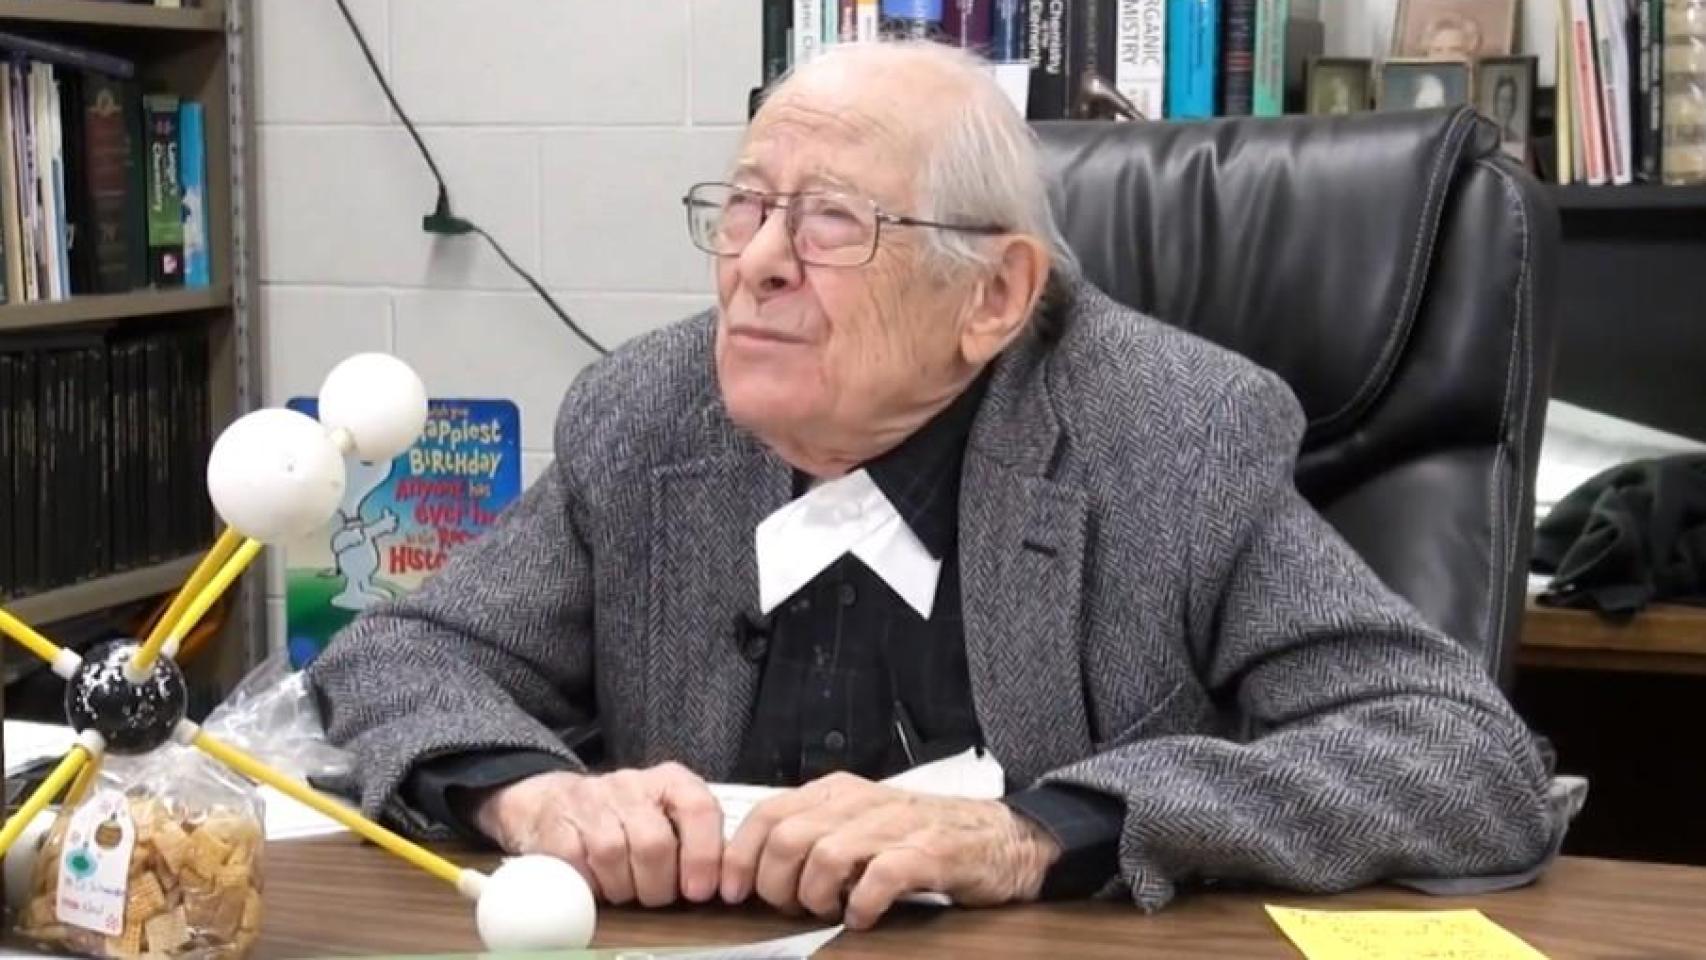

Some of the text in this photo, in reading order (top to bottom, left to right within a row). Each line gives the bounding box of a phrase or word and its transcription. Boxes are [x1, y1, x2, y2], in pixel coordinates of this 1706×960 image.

[1121, 0, 1139, 63] MISTRY
[1143, 0, 1160, 64] RGANIC
[421, 418, 502, 450] appiest
